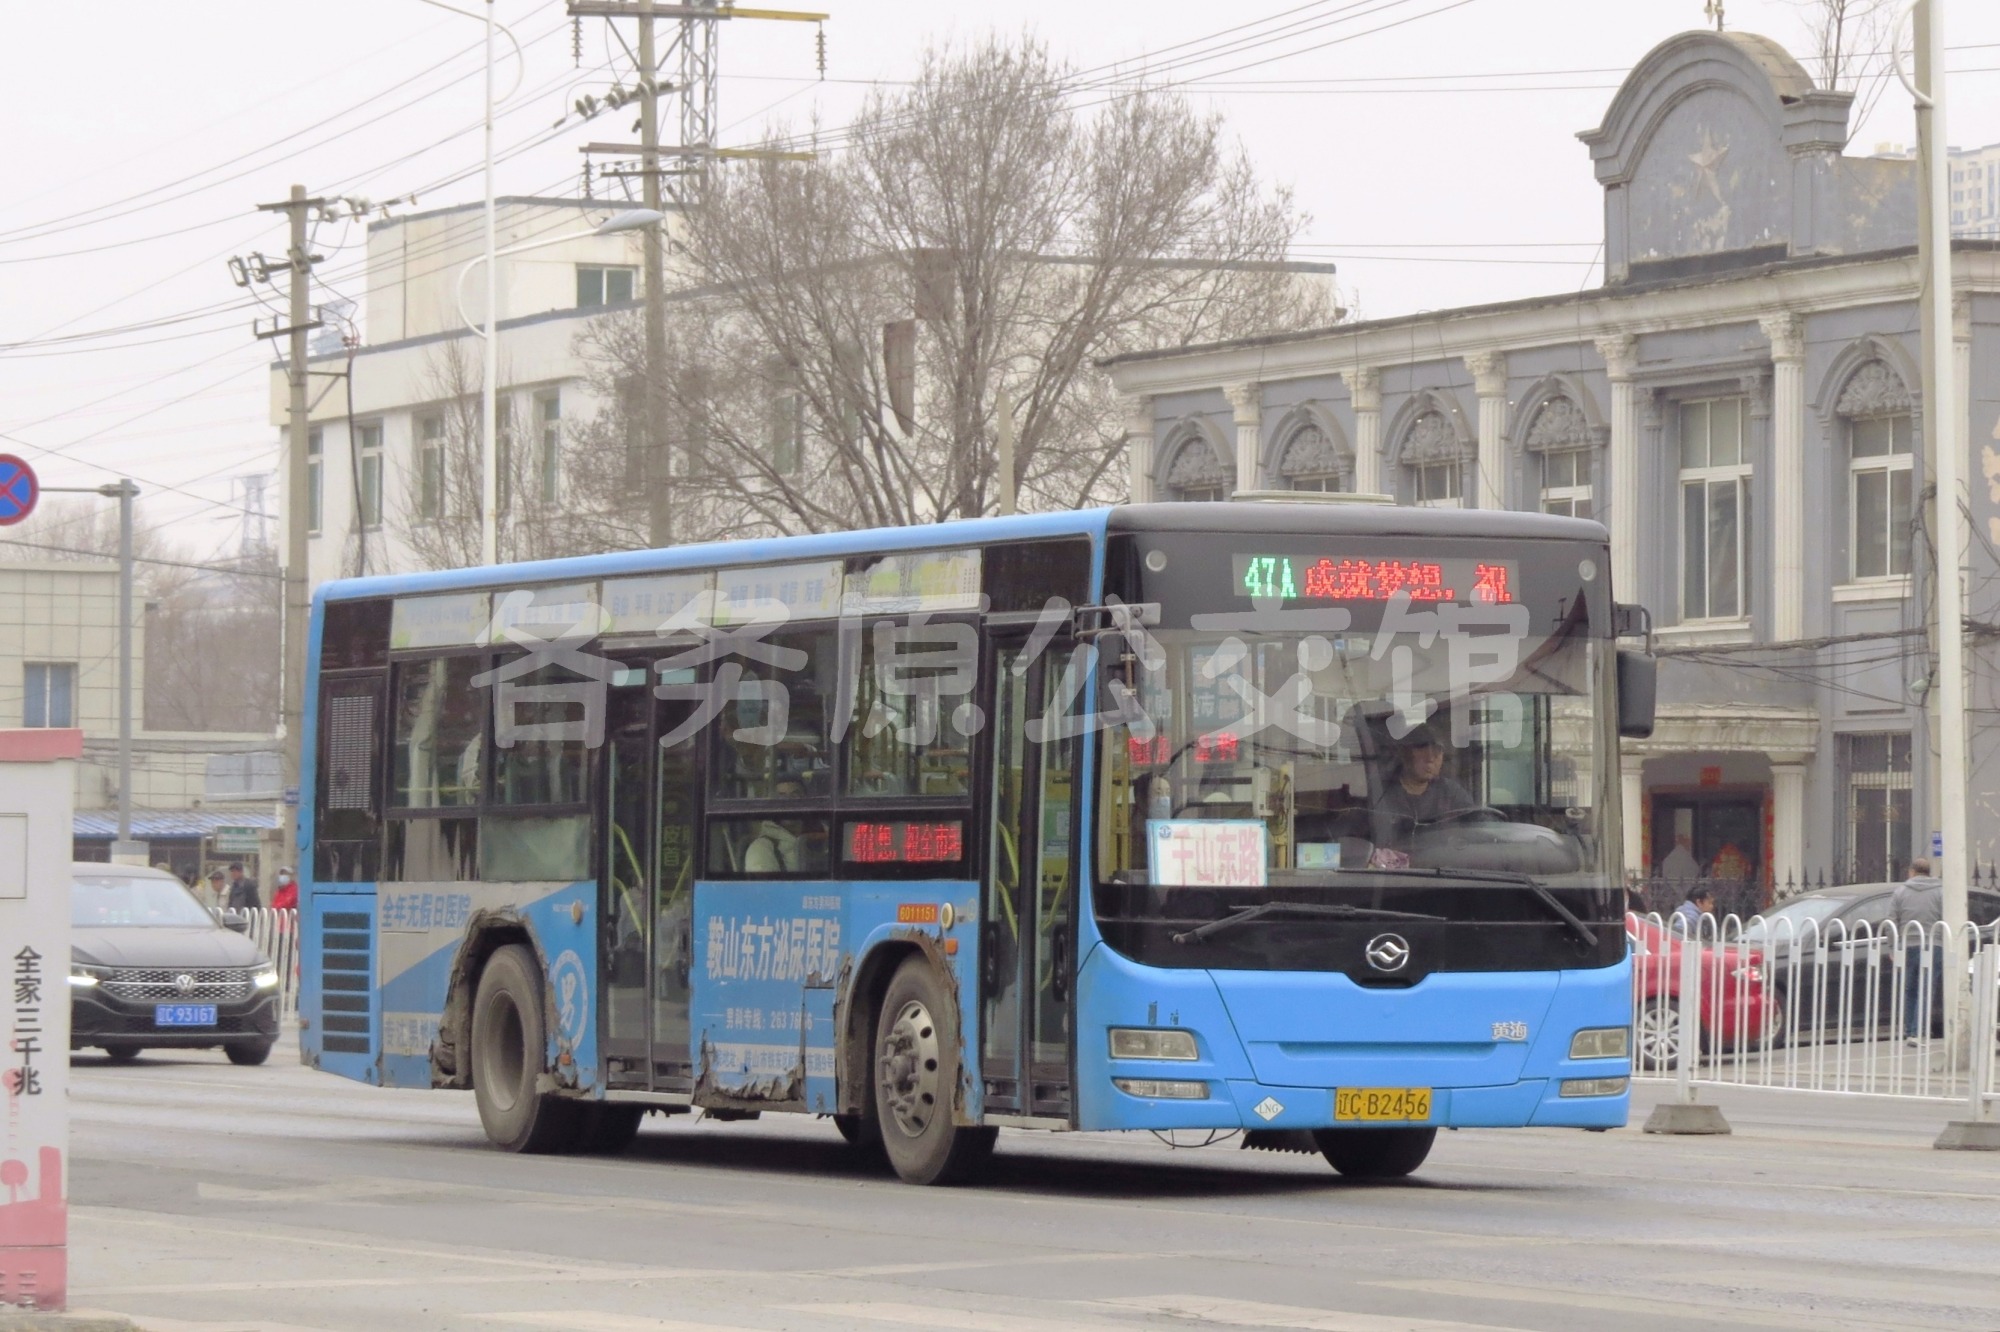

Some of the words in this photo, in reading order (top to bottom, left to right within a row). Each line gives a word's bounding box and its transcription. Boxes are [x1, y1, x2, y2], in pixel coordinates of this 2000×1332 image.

[1245, 557, 1296, 598] 47A
[1172, 825, 1260, 886] 千山东路
[382, 893, 471, 929] 全年无假日医院
[900, 905, 936, 921] 6011151
[706, 915, 841, 982] 鞍山东方泌尿医院
[14, 945, 43, 1096] 全家三千兆
[1491, 1020, 1527, 1040] 黄海
[1258, 1102, 1279, 1114] LNG
